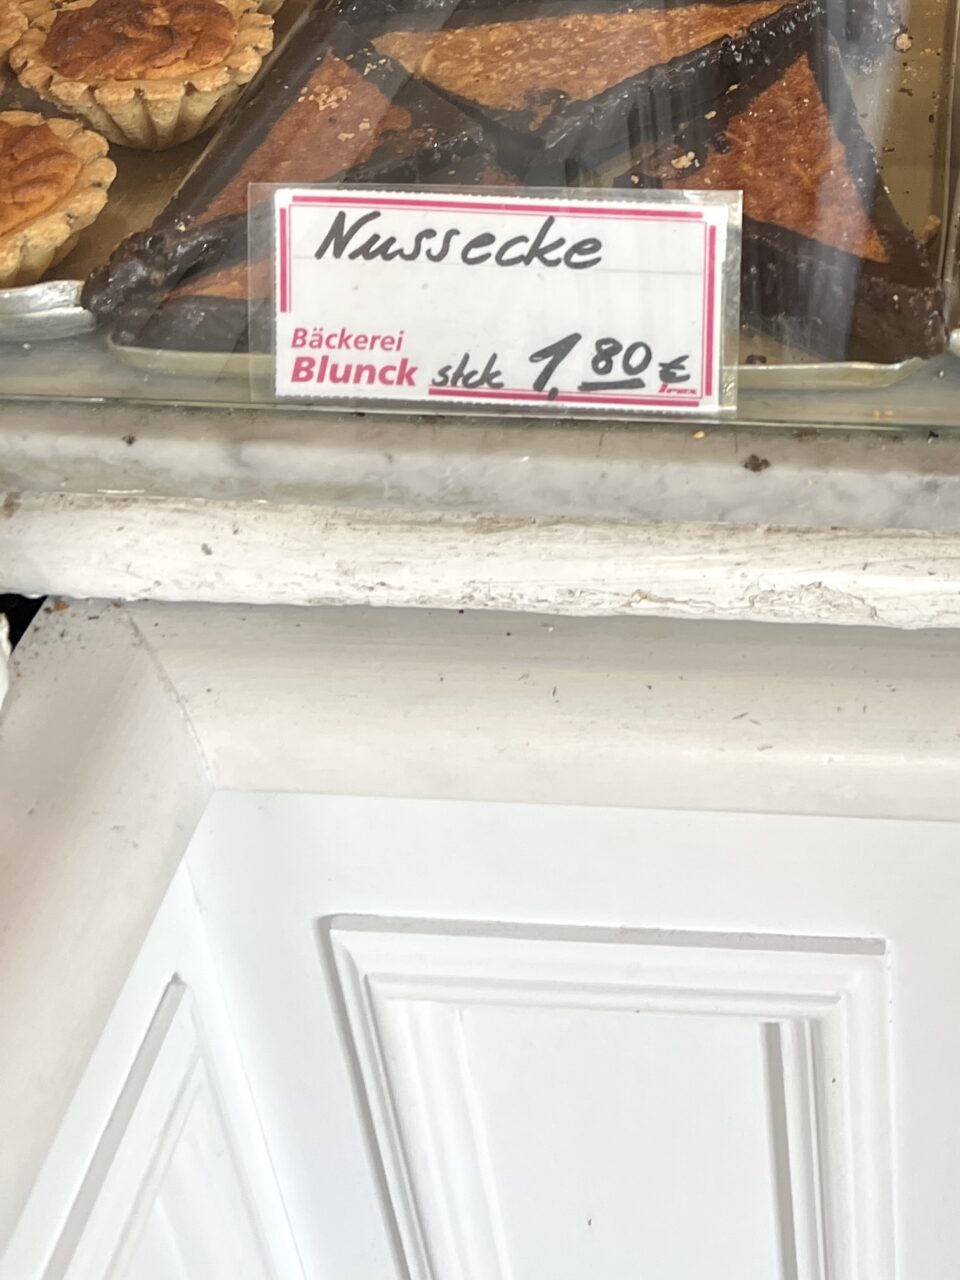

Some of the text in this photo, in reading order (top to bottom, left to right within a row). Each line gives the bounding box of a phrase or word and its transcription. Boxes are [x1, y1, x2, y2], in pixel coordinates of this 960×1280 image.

[315, 211, 602, 269] Nussecke
[290, 328, 405, 352] Bäckerei
[290, 356, 419, 388] Blunck
